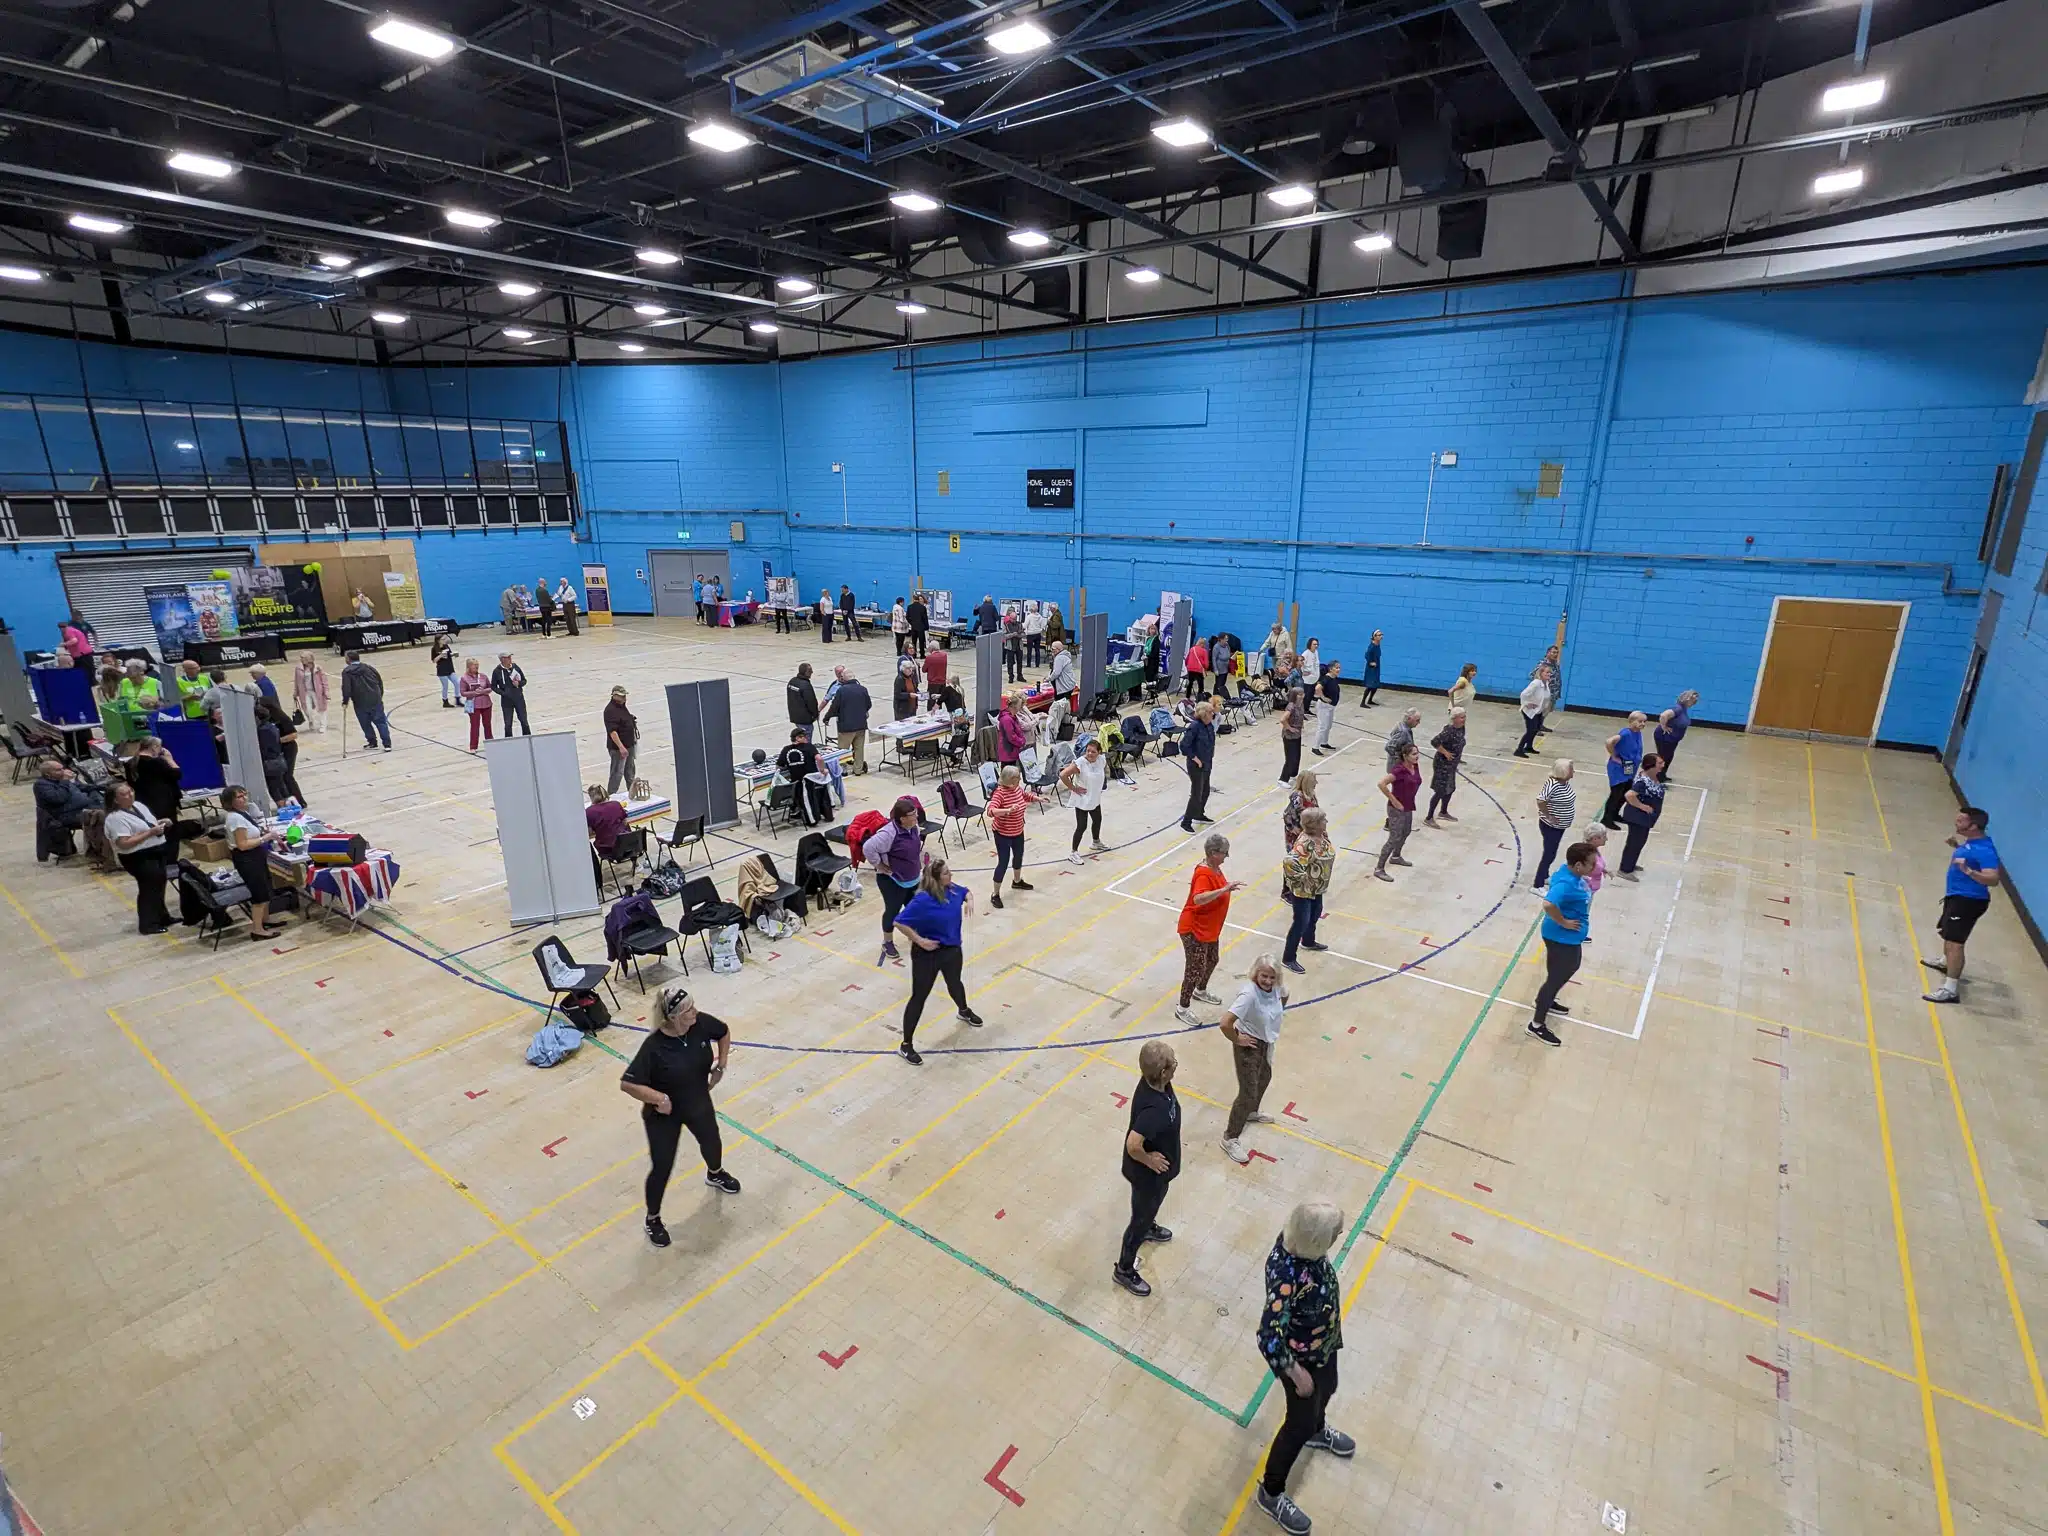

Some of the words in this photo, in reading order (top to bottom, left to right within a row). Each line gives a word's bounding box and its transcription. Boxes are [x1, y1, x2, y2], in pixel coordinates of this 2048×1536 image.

[952, 537, 958, 548] 6
[249, 602, 294, 616] Inspire
[424, 623, 448, 633] Inspire
[362, 634, 392, 645] Inspire
[220, 649, 256, 661] Inspire
